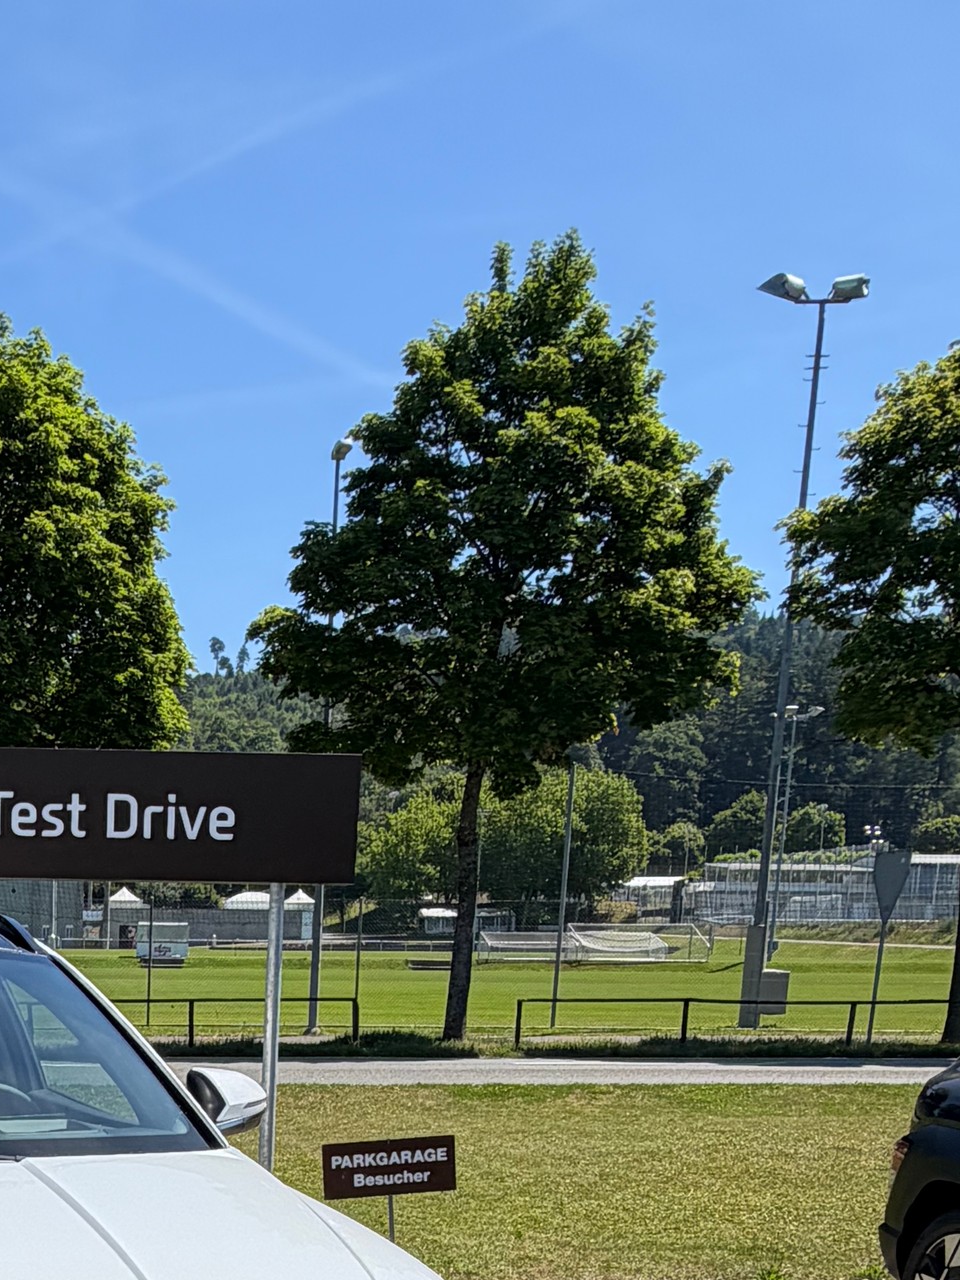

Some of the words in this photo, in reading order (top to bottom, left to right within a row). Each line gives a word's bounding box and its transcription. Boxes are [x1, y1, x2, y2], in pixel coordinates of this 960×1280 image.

[106, 793, 236, 841] Drive
[331, 1147, 448, 1169] PARKGARAGE
[353, 1170, 431, 1188] Besucher
